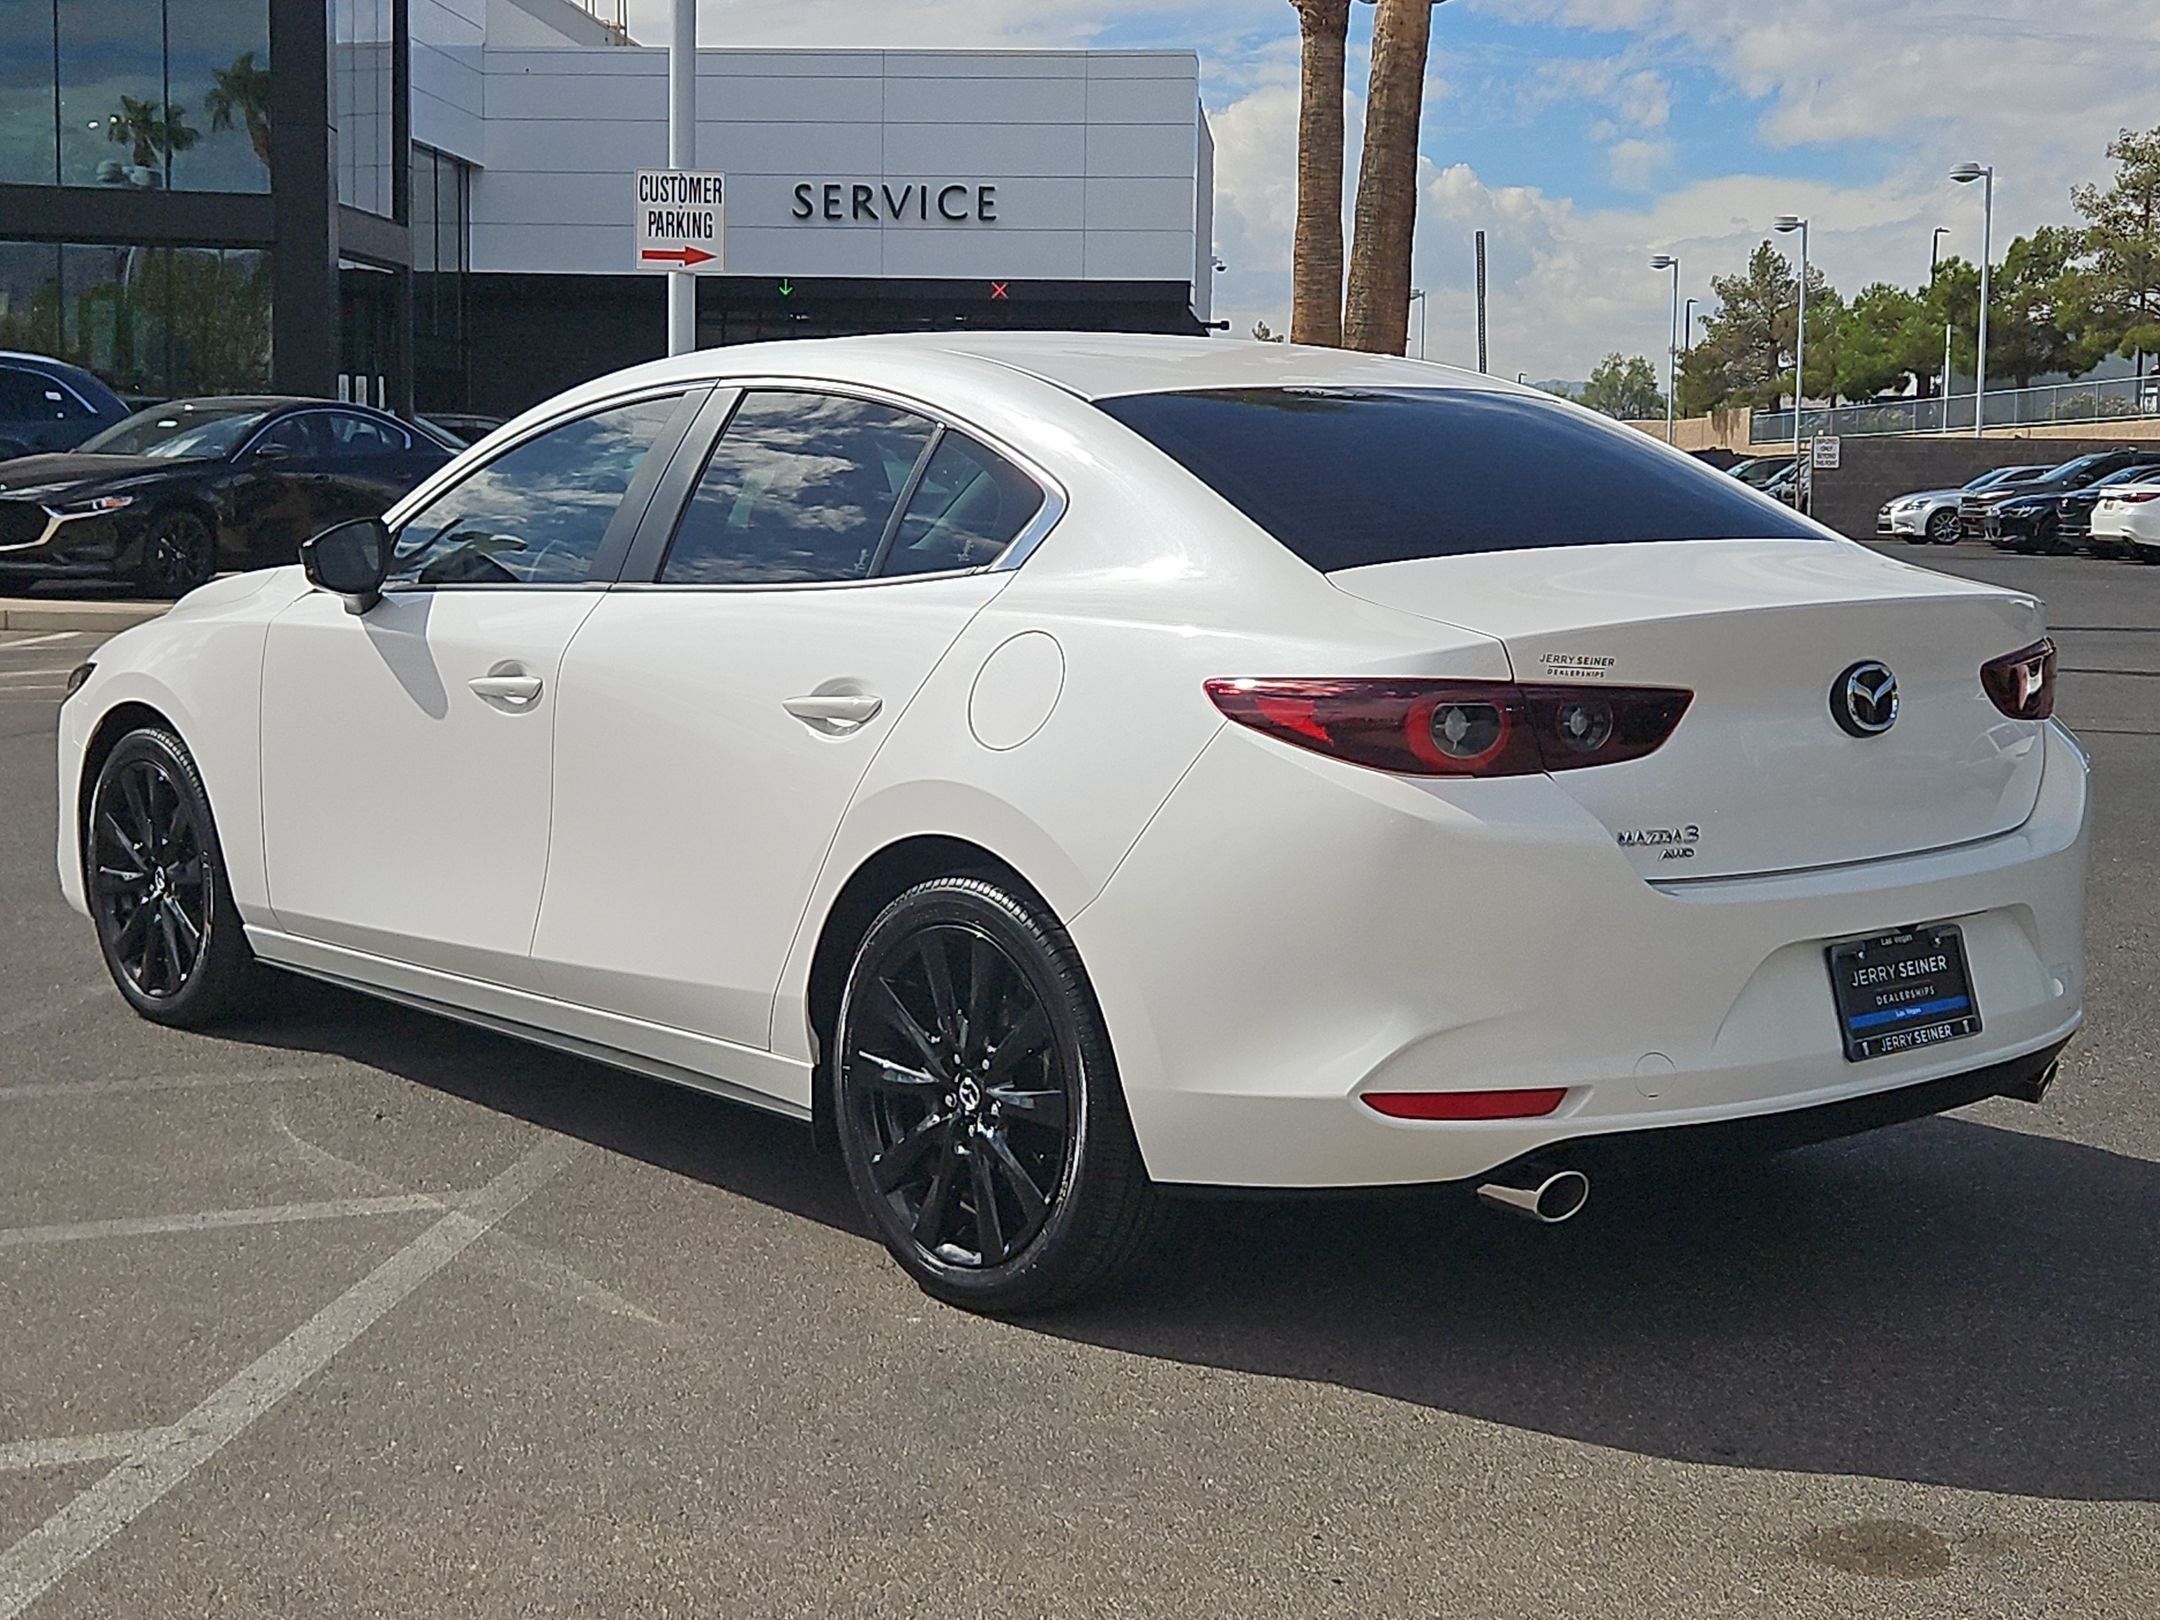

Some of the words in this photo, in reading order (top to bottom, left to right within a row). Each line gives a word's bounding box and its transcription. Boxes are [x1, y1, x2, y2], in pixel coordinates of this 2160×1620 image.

[640, 174, 723, 205] CUSTOMER
[792, 183, 997, 221] SERVICE
[648, 210, 714, 239] PARKING
[1539, 653, 1575, 664] JERRY
[1576, 656, 1615, 667] SEINER
[1547, 668, 1605, 678] DEALERSHIPS
[1657, 847, 1695, 862] AWD
[1851, 964, 1896, 987] JERRY
[1899, 955, 1948, 978] SEINER
[1875, 985, 1935, 1006] DEALERSHIPS
[1881, 1034, 1913, 1052] JERRY
[1915, 1025, 1953, 1044] SEINER
